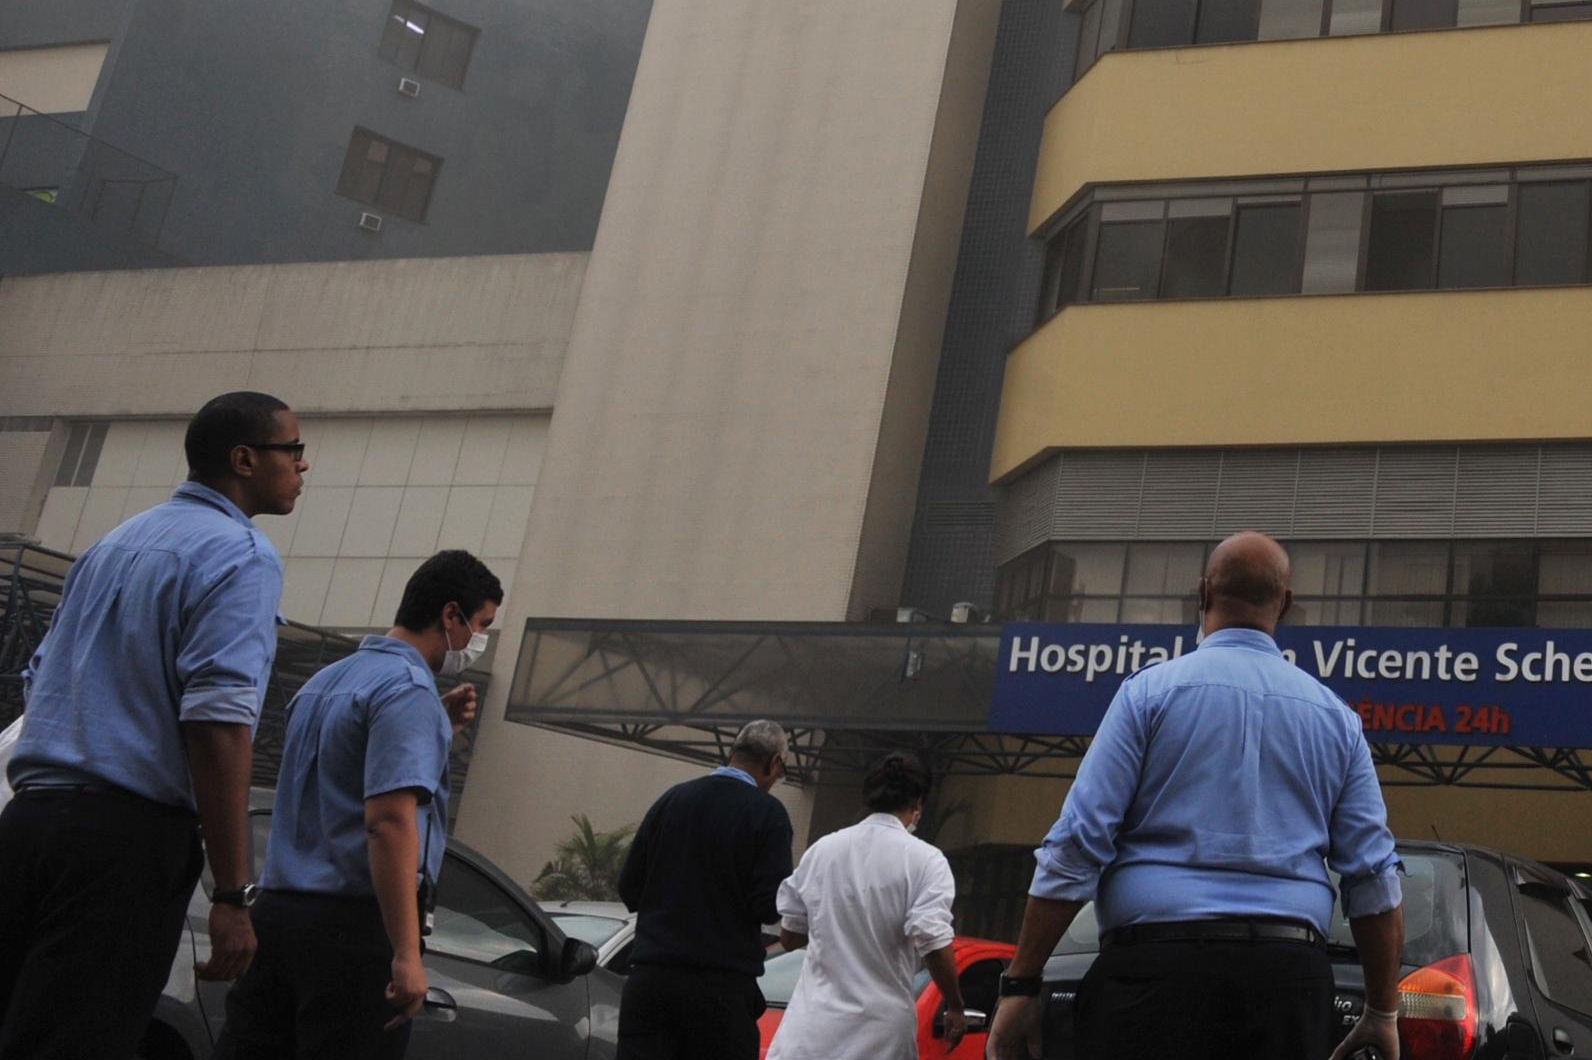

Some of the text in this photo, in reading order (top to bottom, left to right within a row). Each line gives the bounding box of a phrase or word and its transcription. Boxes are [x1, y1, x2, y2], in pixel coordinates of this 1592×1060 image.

[1009, 635, 1183, 682] Hospital
[1312, 638, 1479, 681] Vicente
[1350, 695, 1511, 734] ÊNCIA 24h
